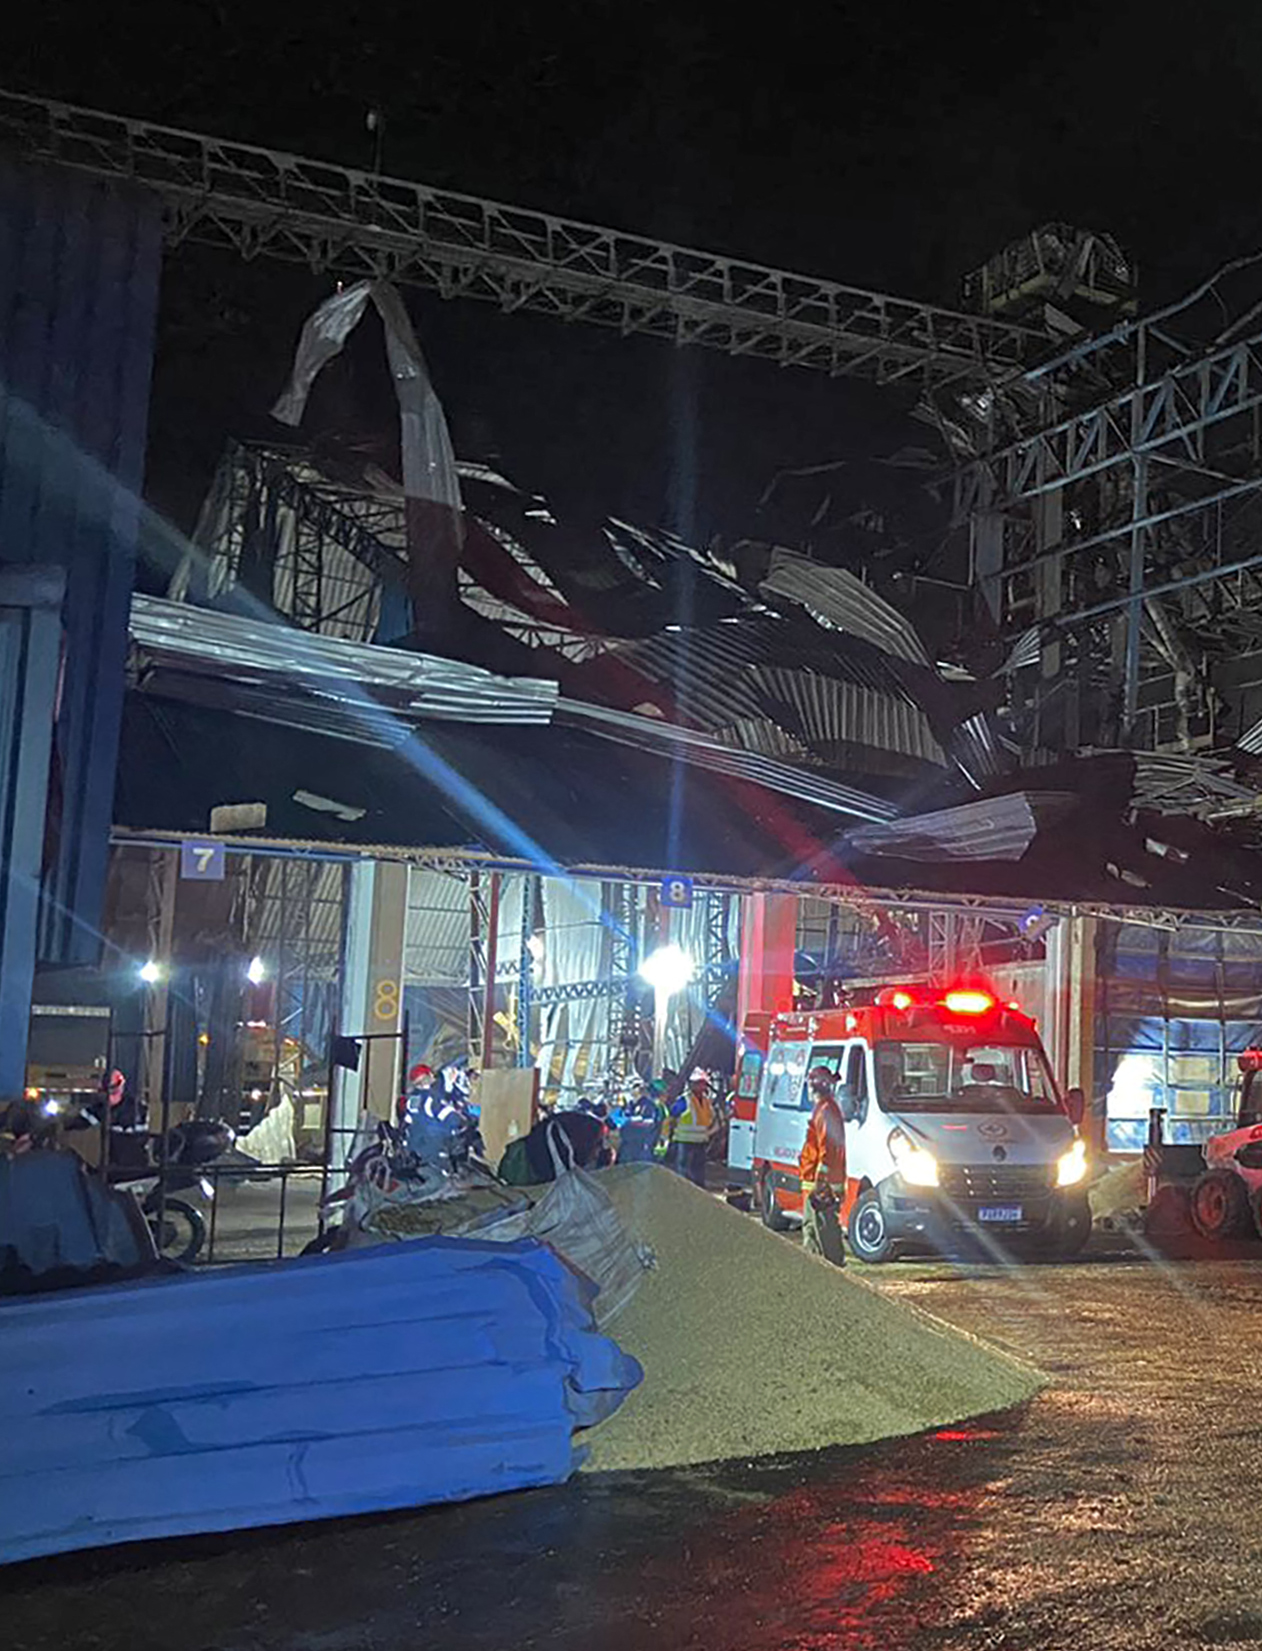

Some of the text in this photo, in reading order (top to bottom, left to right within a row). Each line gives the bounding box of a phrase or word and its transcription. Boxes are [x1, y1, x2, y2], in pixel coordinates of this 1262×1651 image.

[192, 847, 214, 872] 7
[669, 880, 685, 903] 8
[374, 979, 397, 1020] 8
